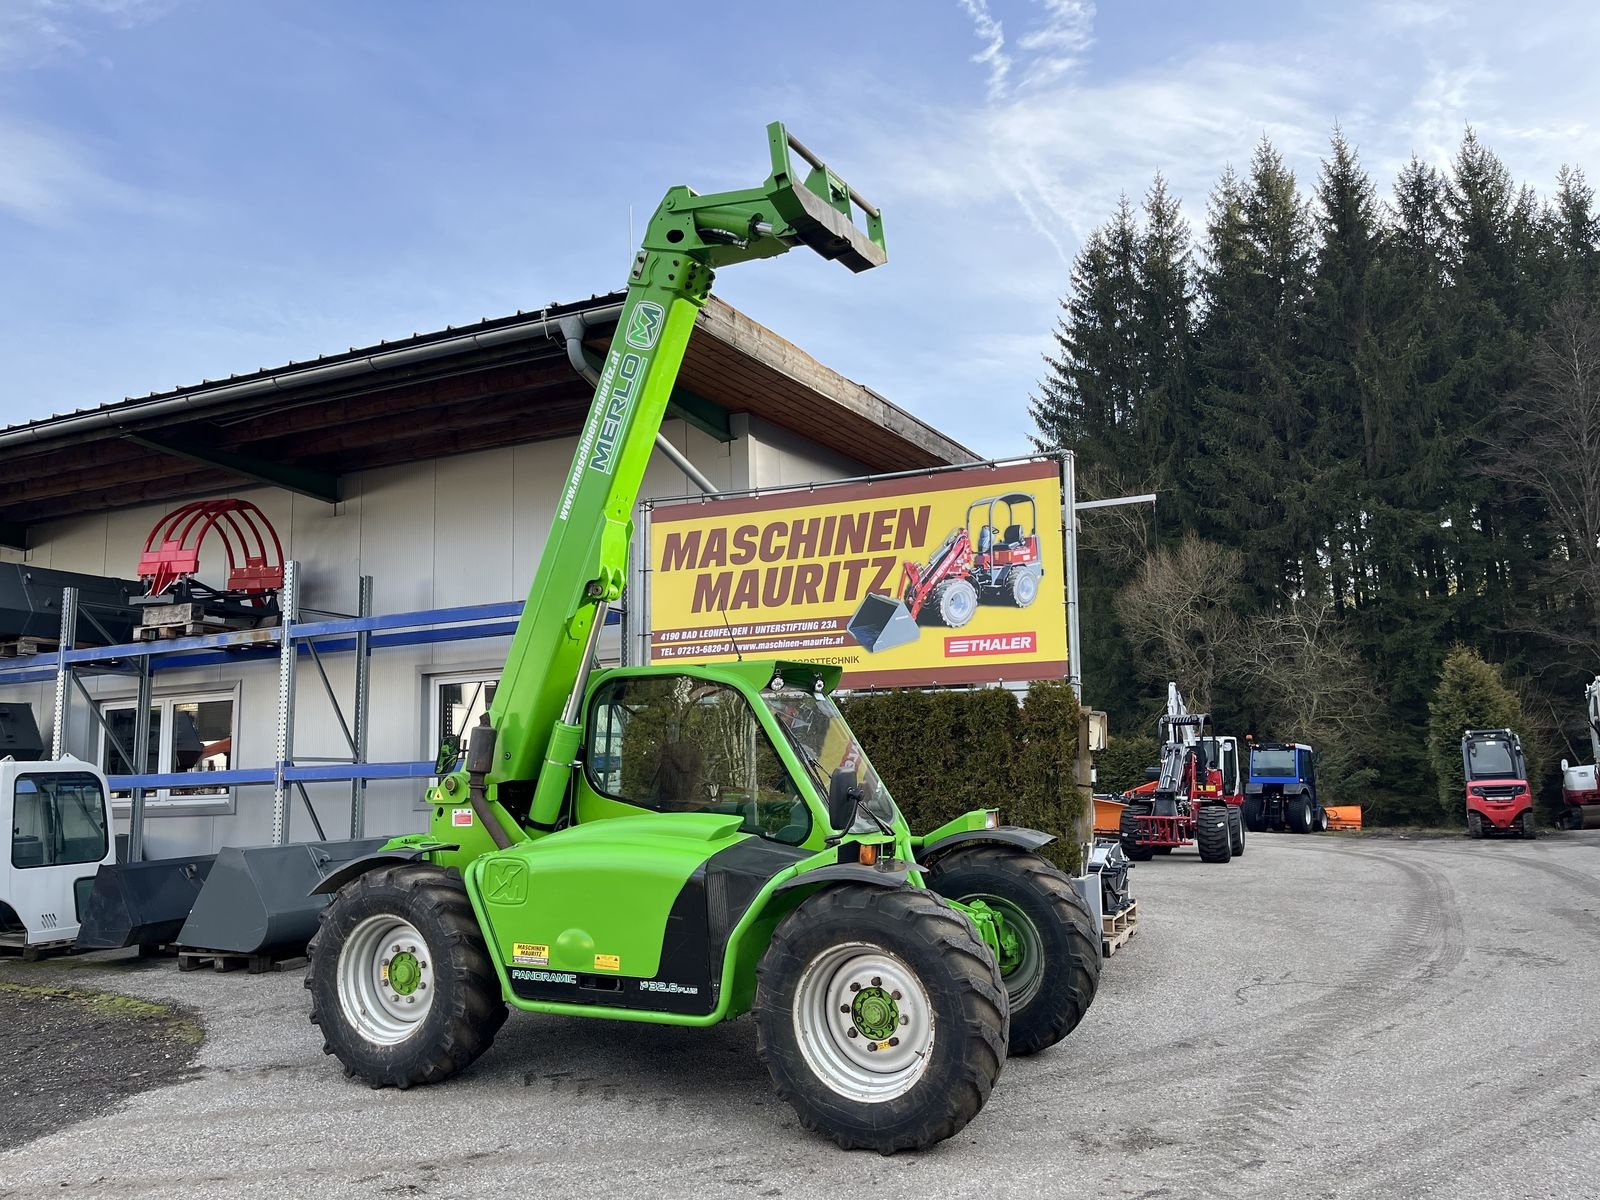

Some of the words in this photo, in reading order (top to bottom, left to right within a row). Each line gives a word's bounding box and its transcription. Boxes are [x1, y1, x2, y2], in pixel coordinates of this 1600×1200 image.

[590, 353, 641, 473] MERLO
[559, 350, 621, 521] www.maschinen-mauritz.at
[660, 505, 932, 572] MASCHINEN
[691, 556, 897, 614] MAURITZ
[660, 632, 680, 641] 4190
[681, 630, 698, 639] BAD
[755, 621, 819, 634] UNTERSTIFTUNG
[820, 620, 837, 630] 23A
[660, 648, 676, 657] TEL.
[677, 644, 730, 655] 07213-6820-0
[737, 636, 845, 652] www.maschinen-mauritz.at
[969, 637, 1032, 652] THALER
[511, 969, 577, 985] PANORAMIC
